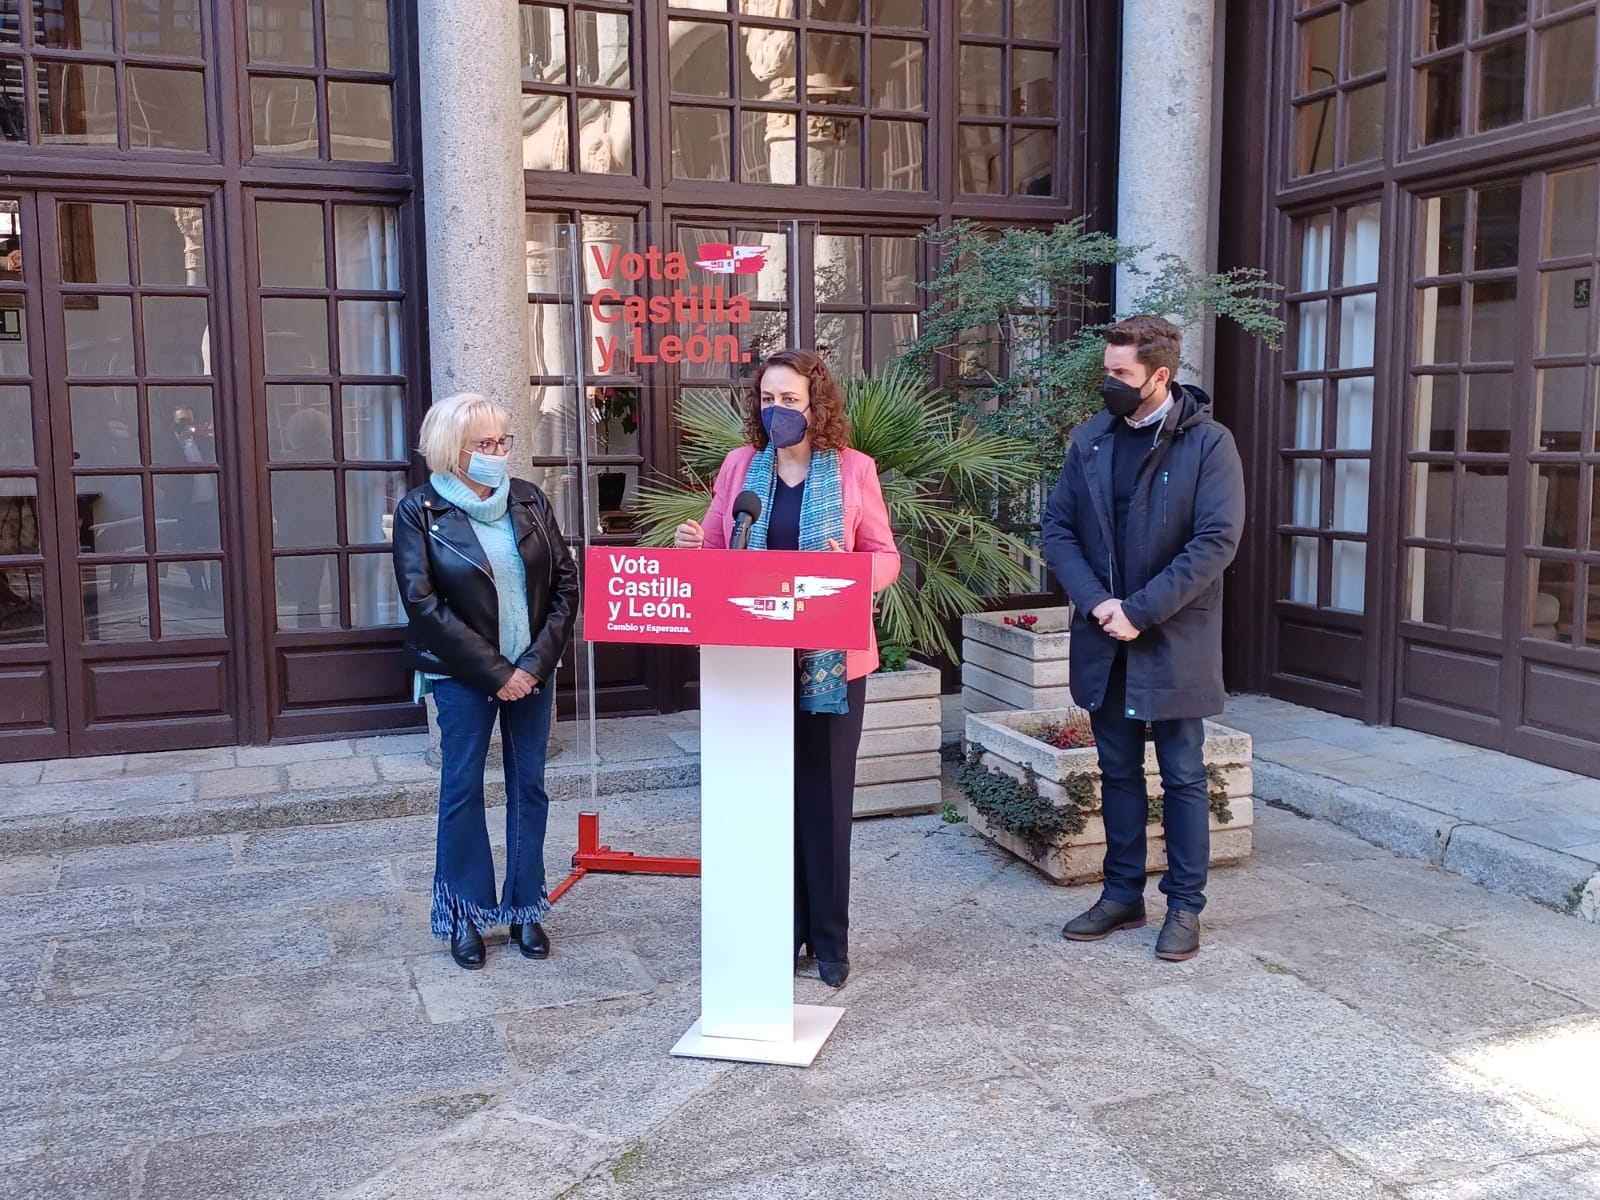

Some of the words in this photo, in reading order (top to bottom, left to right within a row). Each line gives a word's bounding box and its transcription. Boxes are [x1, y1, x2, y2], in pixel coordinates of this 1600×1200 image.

[590, 243, 687, 281] Vota
[591, 285, 751, 324] Castilla
[595, 336, 618, 372] y
[632, 324, 752, 363] León.
[608, 554, 659, 574] Vota
[608, 577, 692, 597] Castilla
[608, 601, 621, 621] y
[629, 597, 691, 618] León.
[607, 623, 638, 631] Cambio
[639, 625, 645, 633] y
[646, 624, 691, 634] Esperanza.
